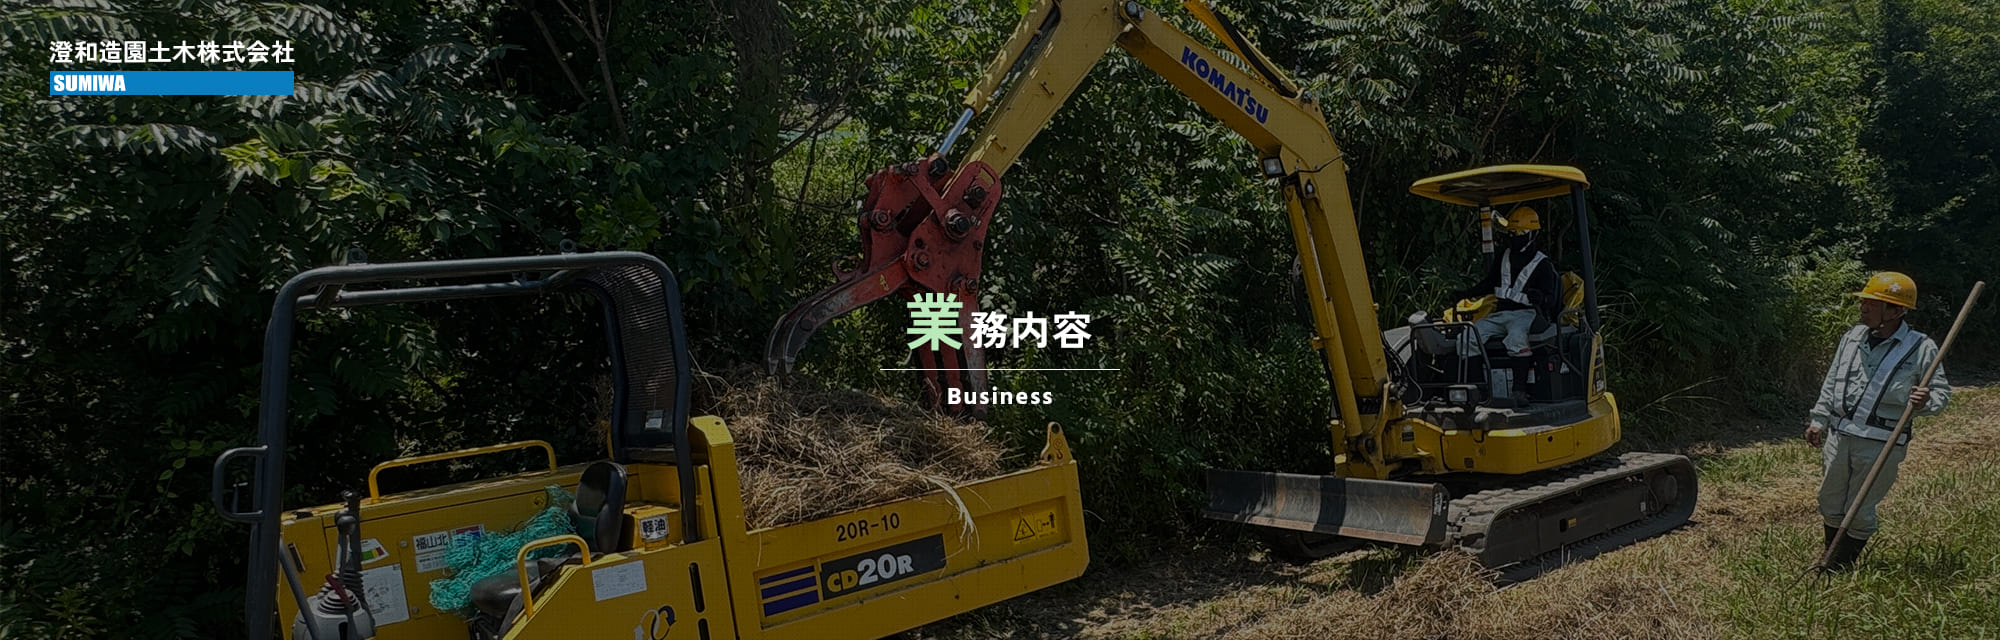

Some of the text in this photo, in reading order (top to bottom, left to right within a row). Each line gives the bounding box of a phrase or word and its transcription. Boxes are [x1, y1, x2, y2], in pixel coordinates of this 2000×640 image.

[1181, 46, 1269, 124] KOMATSU
[642, 518, 666, 533] 軽油
[836, 513, 900, 542] 20R-10
[826, 553, 914, 592] CD20R
